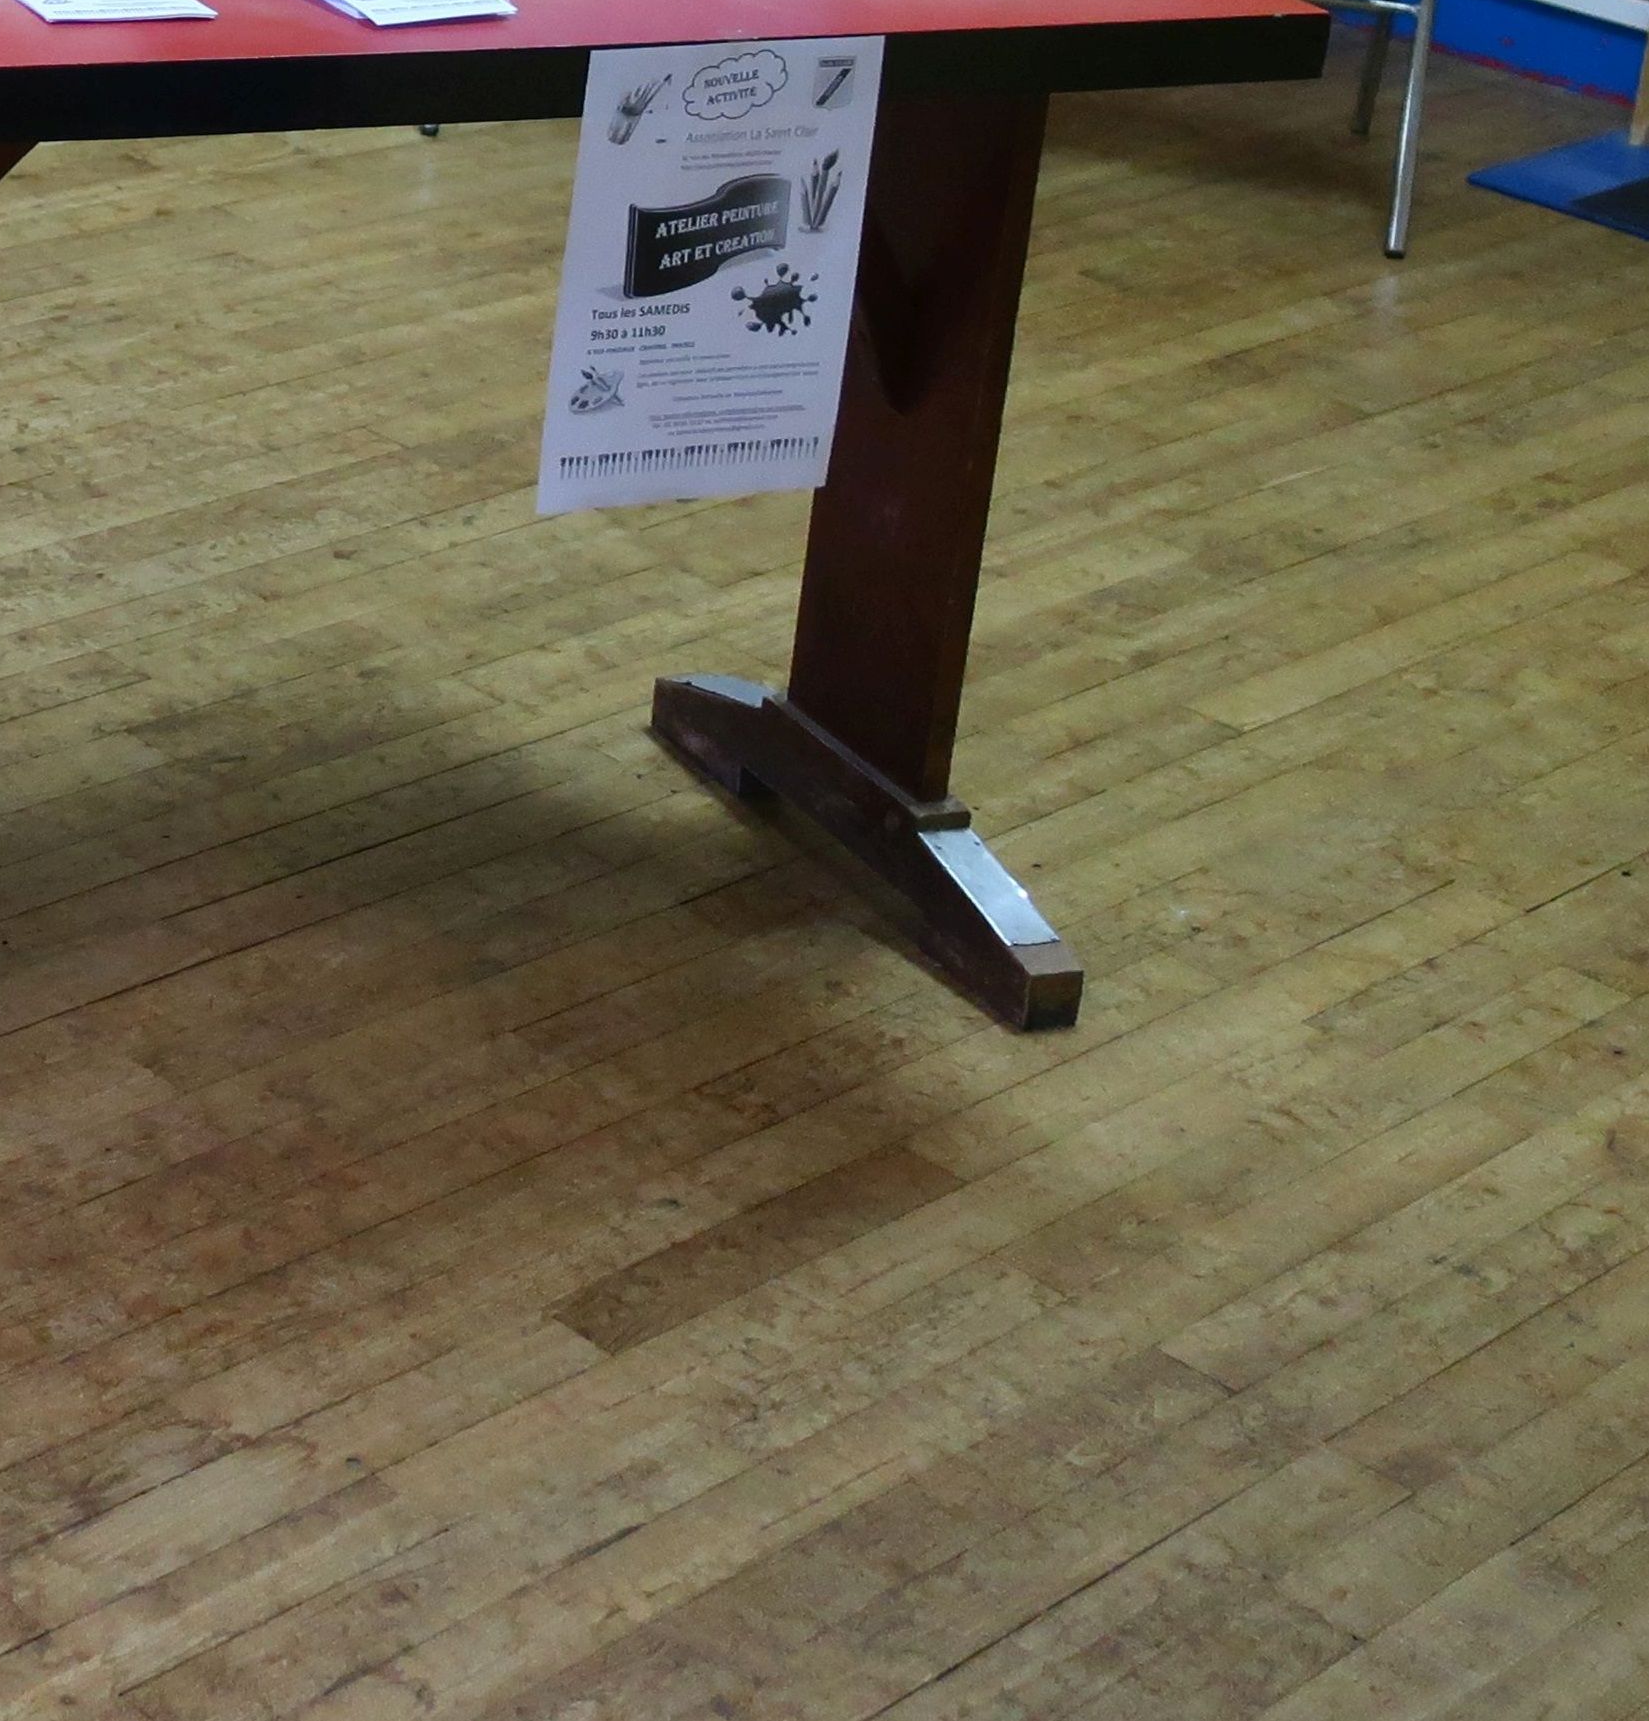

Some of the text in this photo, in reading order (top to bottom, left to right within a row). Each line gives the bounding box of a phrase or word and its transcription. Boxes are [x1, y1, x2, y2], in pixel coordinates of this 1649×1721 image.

[704, 68, 759, 89] NOUVELLE
[655, 201, 779, 239] ATELIER PEINTURE
[658, 228, 776, 270] ART ET CREATION
[592, 302, 691, 320] Tous les SAMEDIS
[591, 328, 619, 341] 9h30
[632, 325, 666, 338] 11h30
